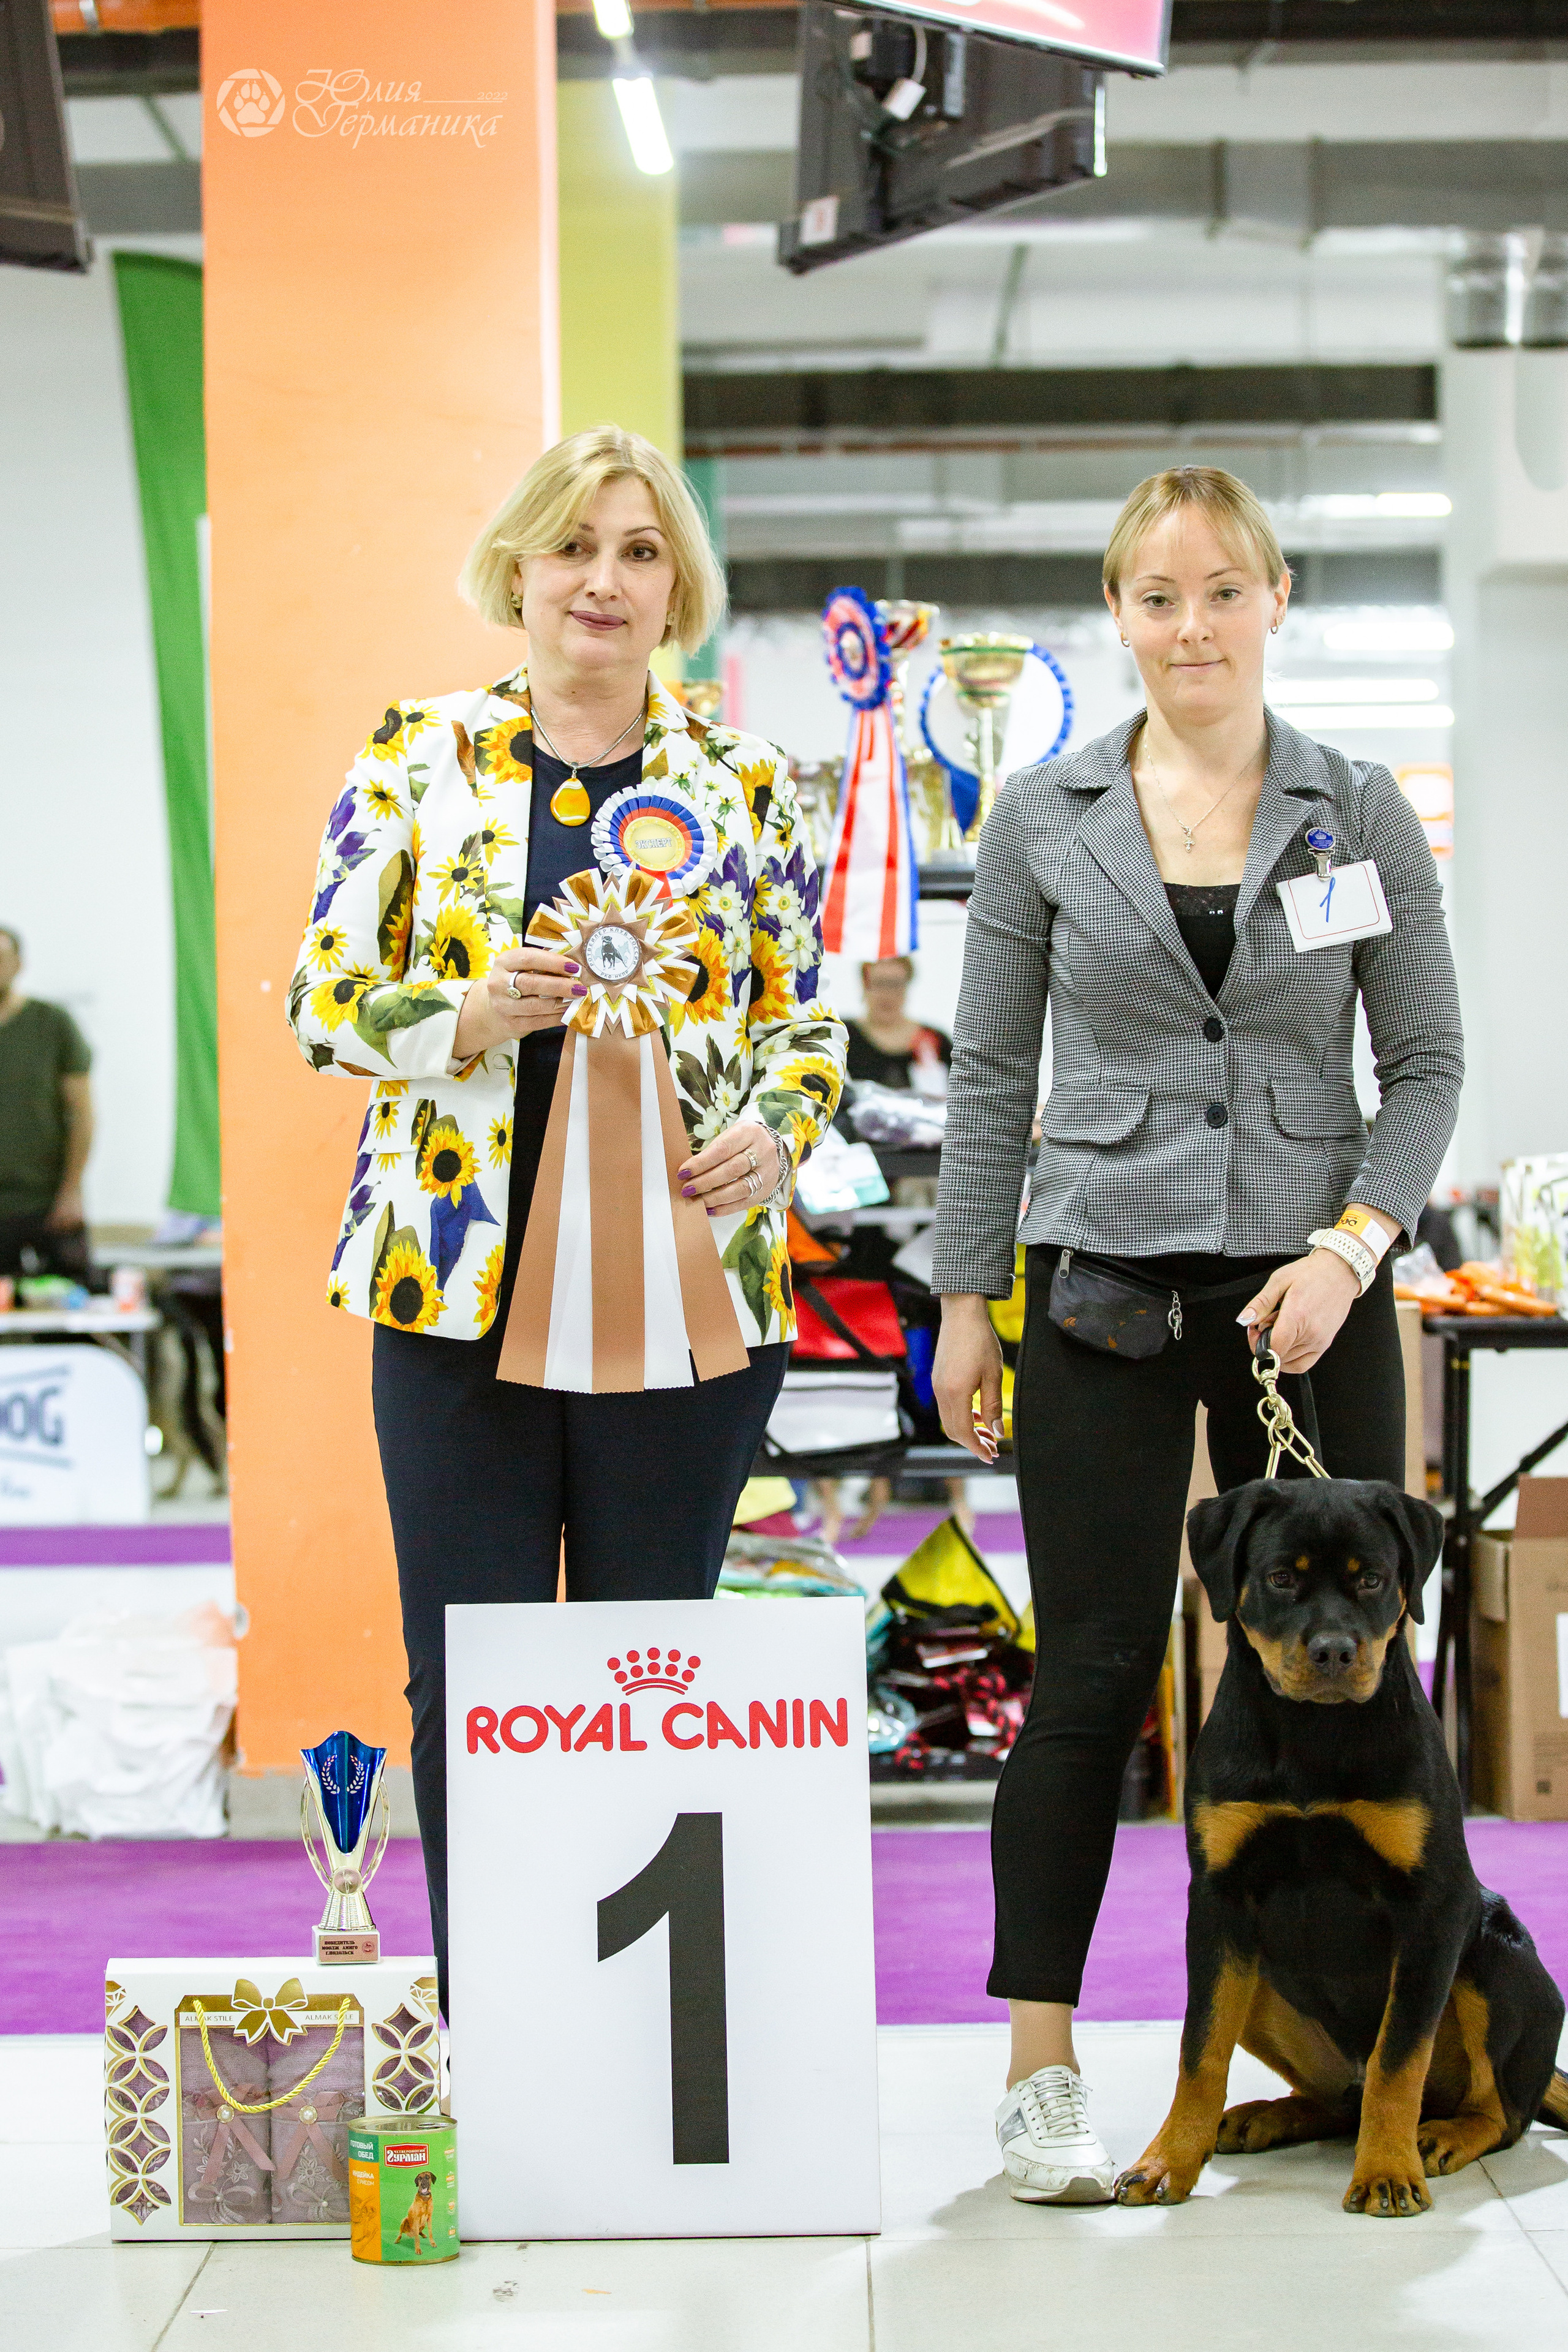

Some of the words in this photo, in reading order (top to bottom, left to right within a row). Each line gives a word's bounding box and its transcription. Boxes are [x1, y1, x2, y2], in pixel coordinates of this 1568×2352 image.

[635, 837, 673, 850] ЭКСПЕРТ
[1319, 876, 1336, 923] 1
[587, 929, 606, 967] РОТВЕЙЛЕР
[609, 927, 628, 937] КЛУБ
[629, 937, 638, 965] РОССИИ
[467, 1703, 647, 1754] ROYAL
[662, 1698, 848, 1750] CANIN
[597, 1811, 729, 2165] 1
[350, 2139, 374, 2150] ГОТОВЫЙ
[358, 2150, 374, 2160] ОБЕД
[352, 2169, 374, 2179] ИНДЕЙКА
